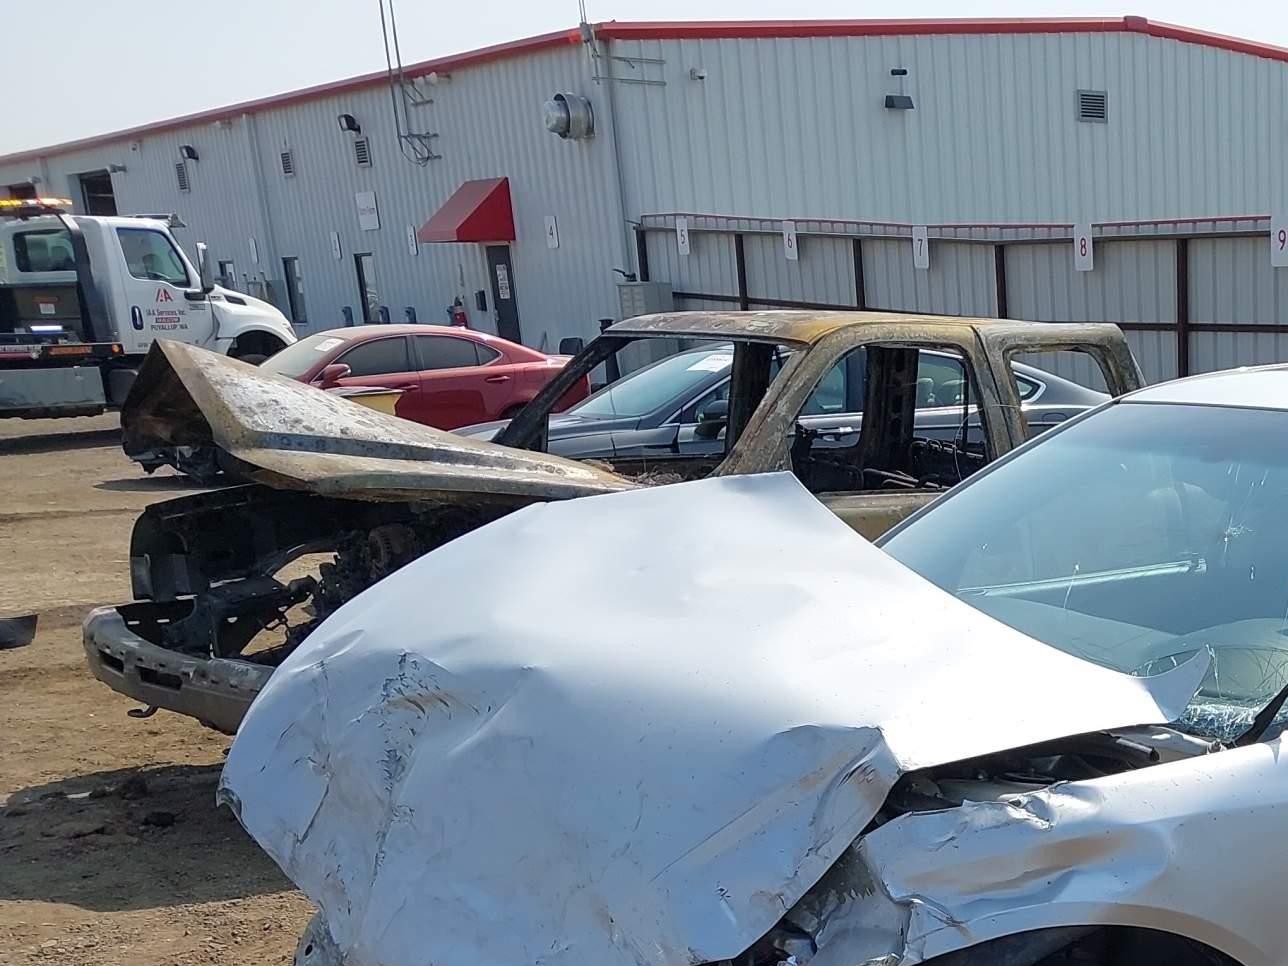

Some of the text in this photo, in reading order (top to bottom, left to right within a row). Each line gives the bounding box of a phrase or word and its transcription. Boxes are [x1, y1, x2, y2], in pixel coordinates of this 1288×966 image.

[548, 225, 554, 239] 4
[680, 229, 686, 245] 5
[1278, 229, 1287, 251] 9
[787, 233, 793, 249] 6
[917, 238, 923, 257] 7
[1080, 236, 1087, 257] 8
